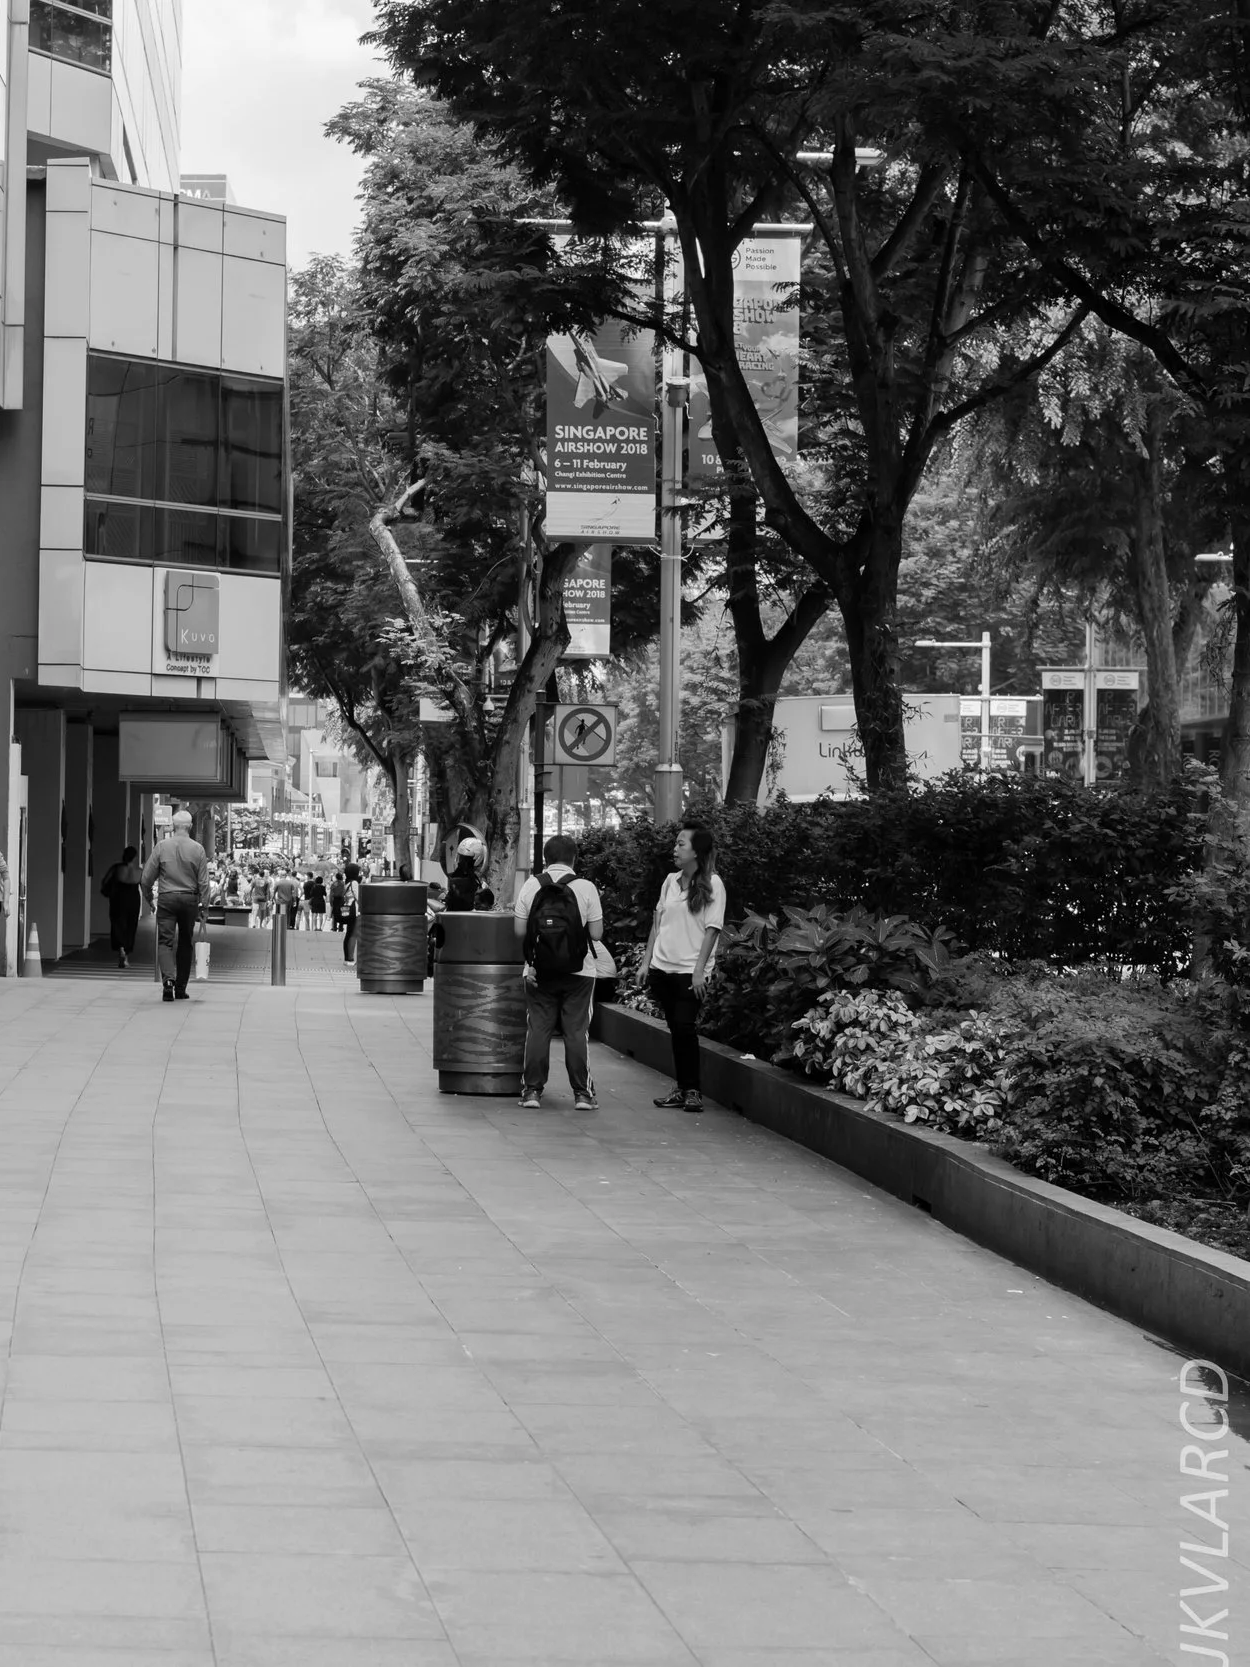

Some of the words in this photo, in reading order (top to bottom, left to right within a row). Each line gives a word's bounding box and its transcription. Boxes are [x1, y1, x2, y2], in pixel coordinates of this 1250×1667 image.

[745, 263, 777, 271] Possible
[554, 425, 648, 440] SINGAPORE
[554, 441, 617, 453] AIRSHOW
[620, 443, 648, 454] 2018
[554, 459, 561, 468] 6
[573, 459, 581, 468] 11
[583, 459, 627, 471] February
[701, 454, 714, 465] 10
[554, 483, 648, 491] www.singaporeairshow.com
[586, 590, 606, 598] 2018
[563, 600, 591, 610] ebruary
[181, 628, 215, 644] Kuvo
[175, 653, 210, 664] Lifestyle
[166, 663, 189, 673] Concept
[190, 664, 197, 674] by
